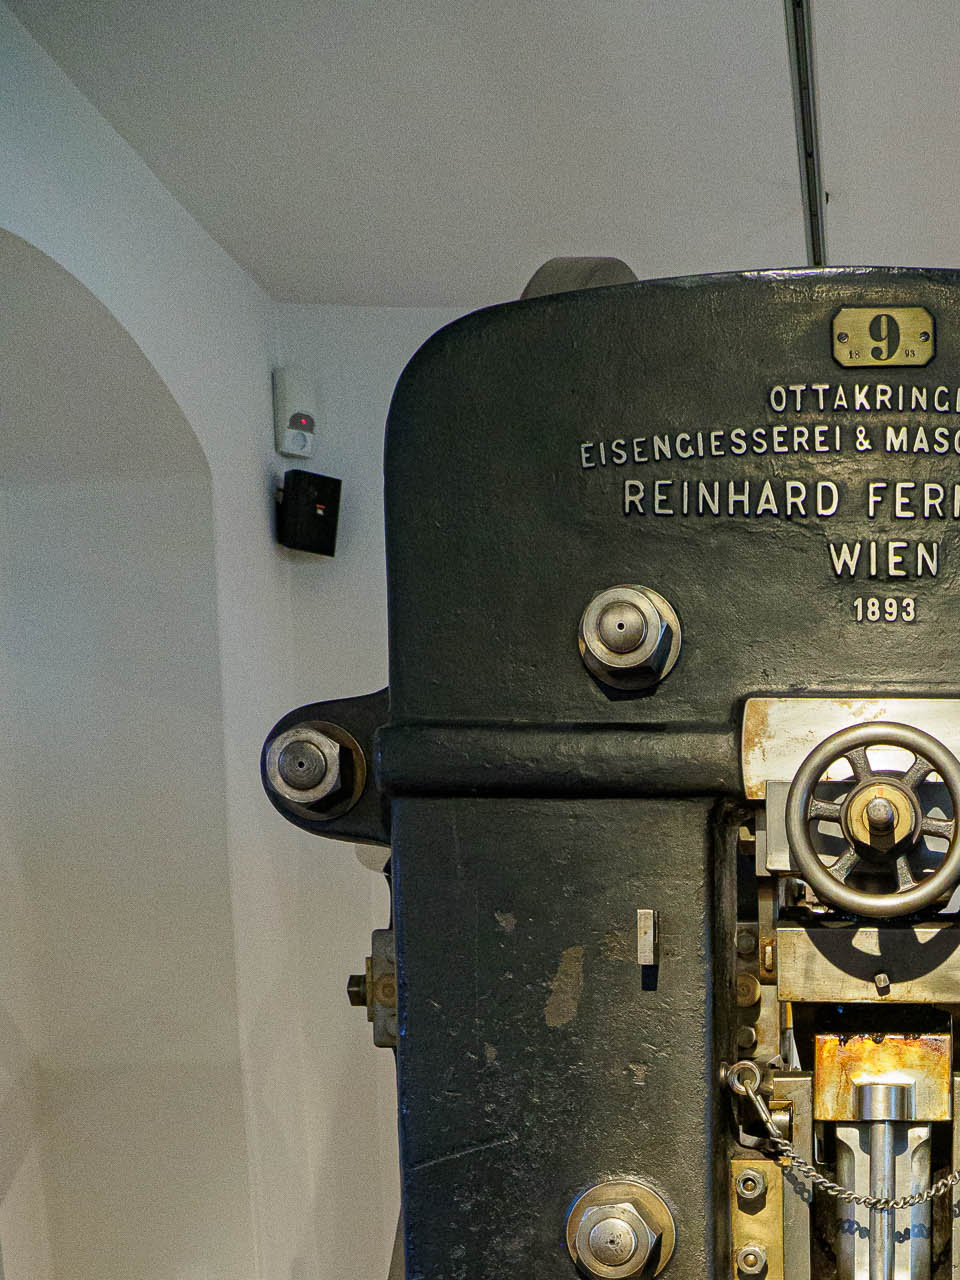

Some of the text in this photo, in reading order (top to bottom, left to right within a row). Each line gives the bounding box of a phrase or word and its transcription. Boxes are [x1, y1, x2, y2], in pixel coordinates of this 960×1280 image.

[848, 349, 916, 359] 18 93
[869, 313, 900, 361] 9
[580, 425, 841, 469] EISENGIESSEREI
[855, 425, 872, 450] &
[623, 479, 839, 516] REINHARD
[828, 540, 939, 577] WIEN
[853, 597, 916, 622] 1893
